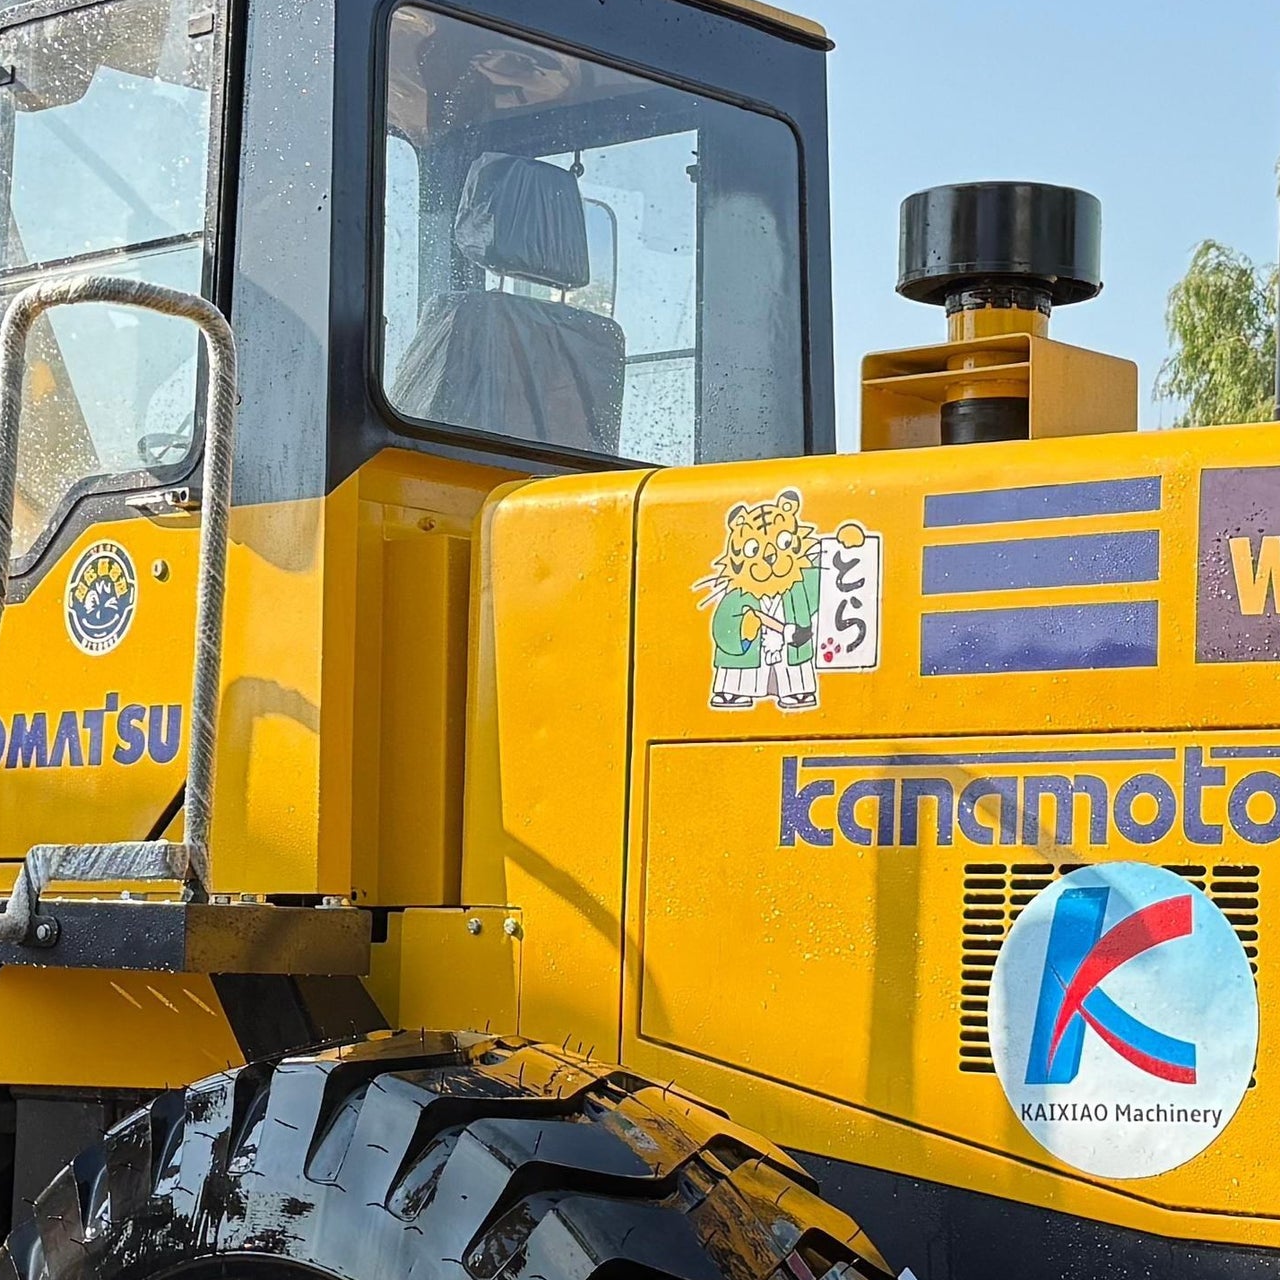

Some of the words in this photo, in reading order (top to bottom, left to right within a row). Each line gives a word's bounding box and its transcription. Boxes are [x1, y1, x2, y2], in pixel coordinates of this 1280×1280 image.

[832, 550, 867, 654] とら
[1021, 1103, 1108, 1121] KAIXIAO
[1115, 1103, 1223, 1128] Machinery
